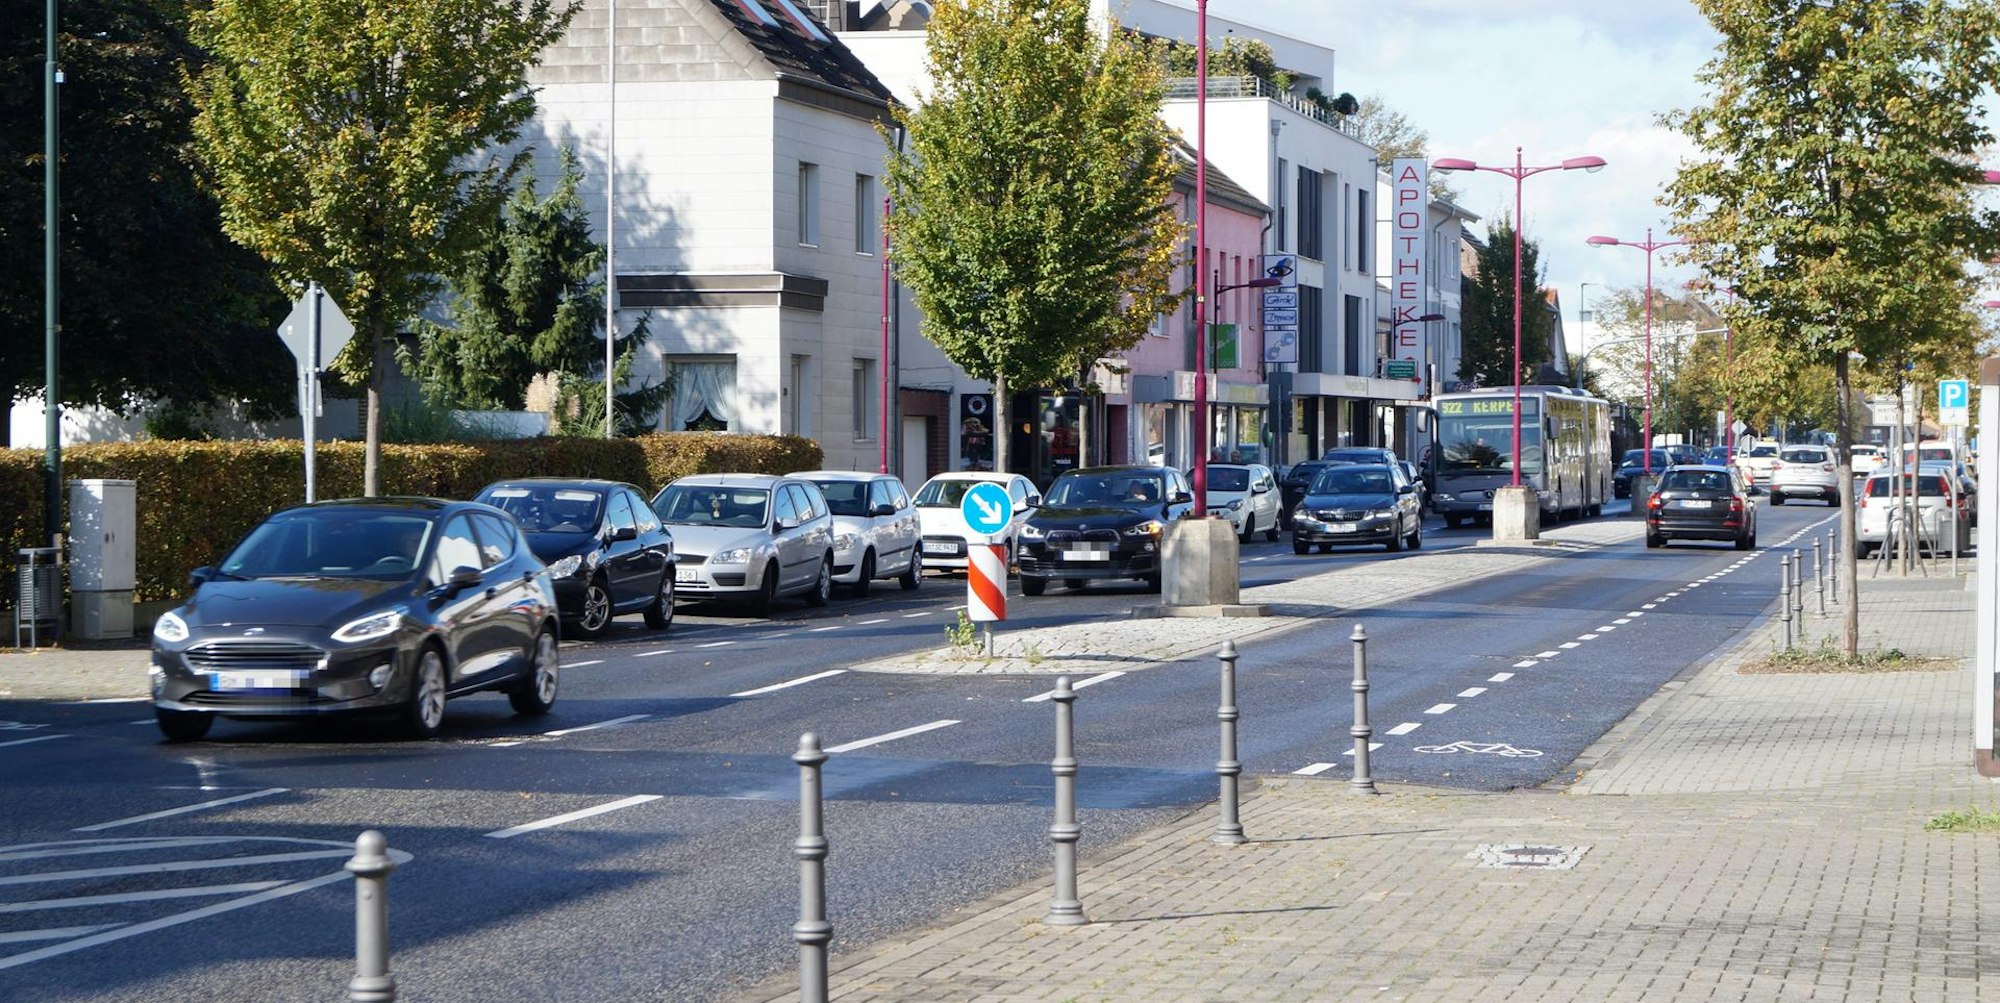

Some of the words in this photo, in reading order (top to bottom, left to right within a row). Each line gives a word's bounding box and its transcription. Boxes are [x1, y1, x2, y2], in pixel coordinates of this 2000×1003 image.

[1398, 165, 1420, 347] APOTHEKE
[1473, 401, 1514, 413] KERPE
[1945, 384, 1961, 407] P
